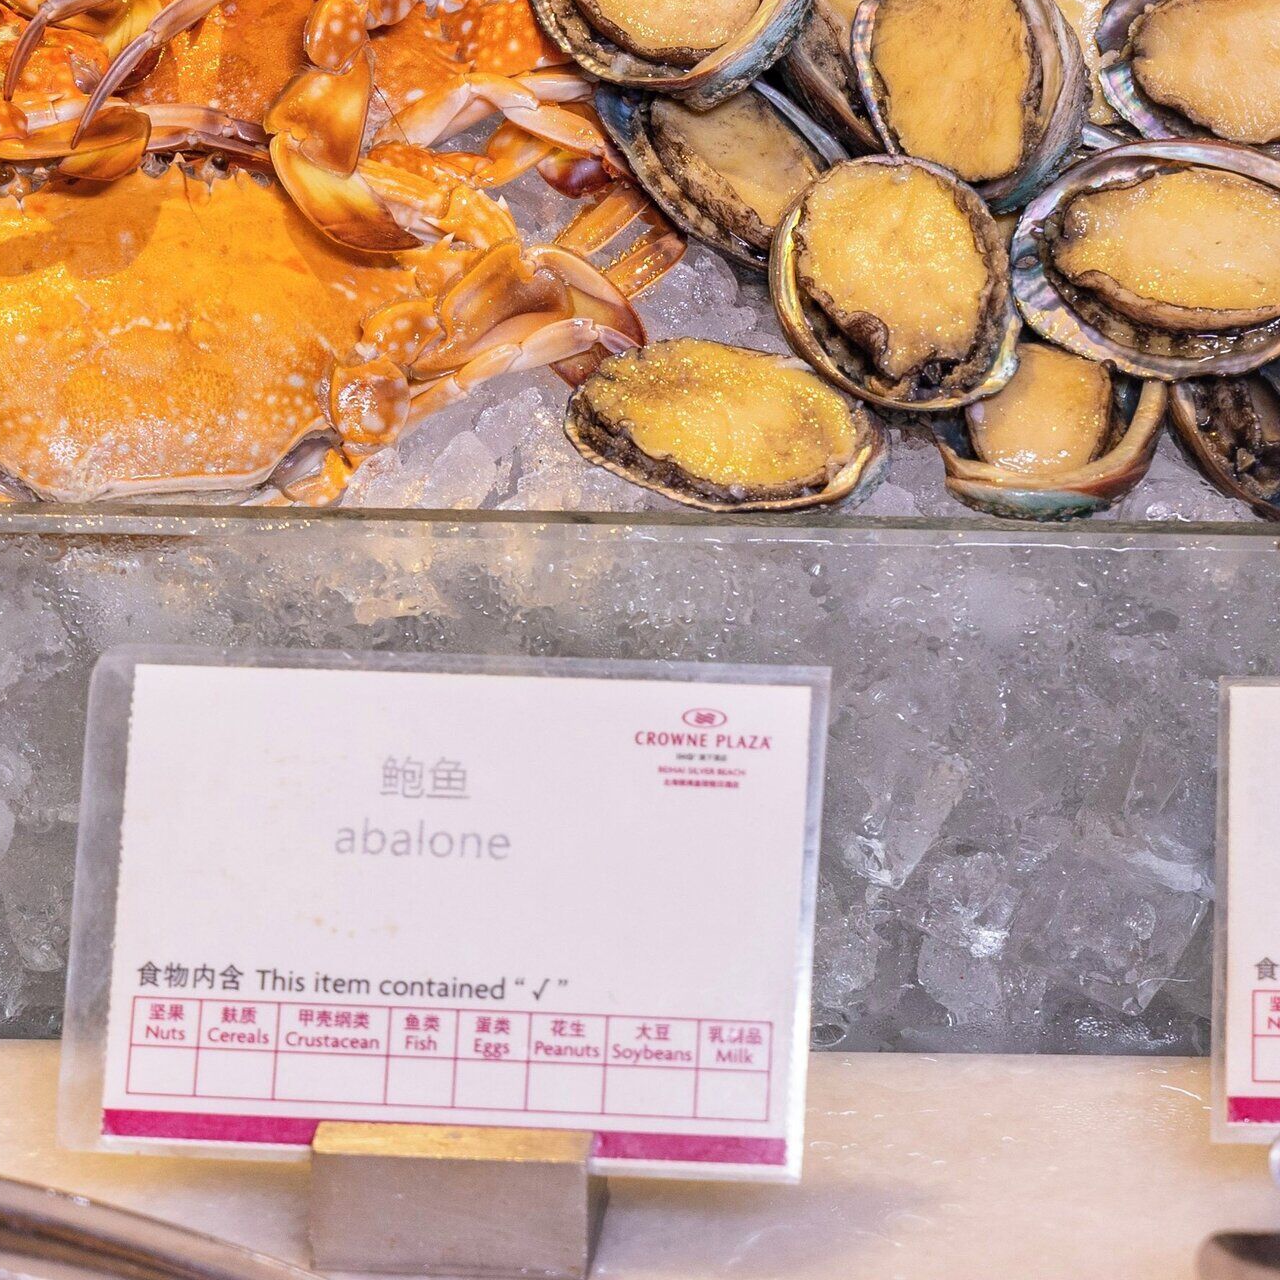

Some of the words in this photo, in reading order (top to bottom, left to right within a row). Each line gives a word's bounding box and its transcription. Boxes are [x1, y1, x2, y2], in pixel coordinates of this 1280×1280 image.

[635, 731, 706, 747] CROWNE
[716, 734, 770, 749] PLAZA
[380, 756, 470, 800] 鲍鱼
[335, 817, 511, 861] abalone
[137, 961, 244, 990] 食物内含
[256, 968, 305, 992] This
[315, 972, 370, 994] item
[379, 977, 505, 1000] contained
[149, 1004, 184, 1021] 坚果
[299, 1009, 369, 1029] 甲壳纲类
[405, 1013, 439, 1031] 鱼类
[476, 1016, 510, 1034] 蛋类
[551, 1019, 585, 1037] 花生
[636, 1024, 670, 1041] 大豆
[145, 1025, 185, 1040] Nuts
[208, 1027, 269, 1044] Cereals
[284, 1032, 379, 1051] Crustacean
[405, 1035, 437, 1051] Fish
[473, 1039, 510, 1060] Eggs
[534, 1041, 600, 1058] Peanuts
[611, 1044, 692, 1065] Soybeans
[716, 1049, 752, 1063] Milk
